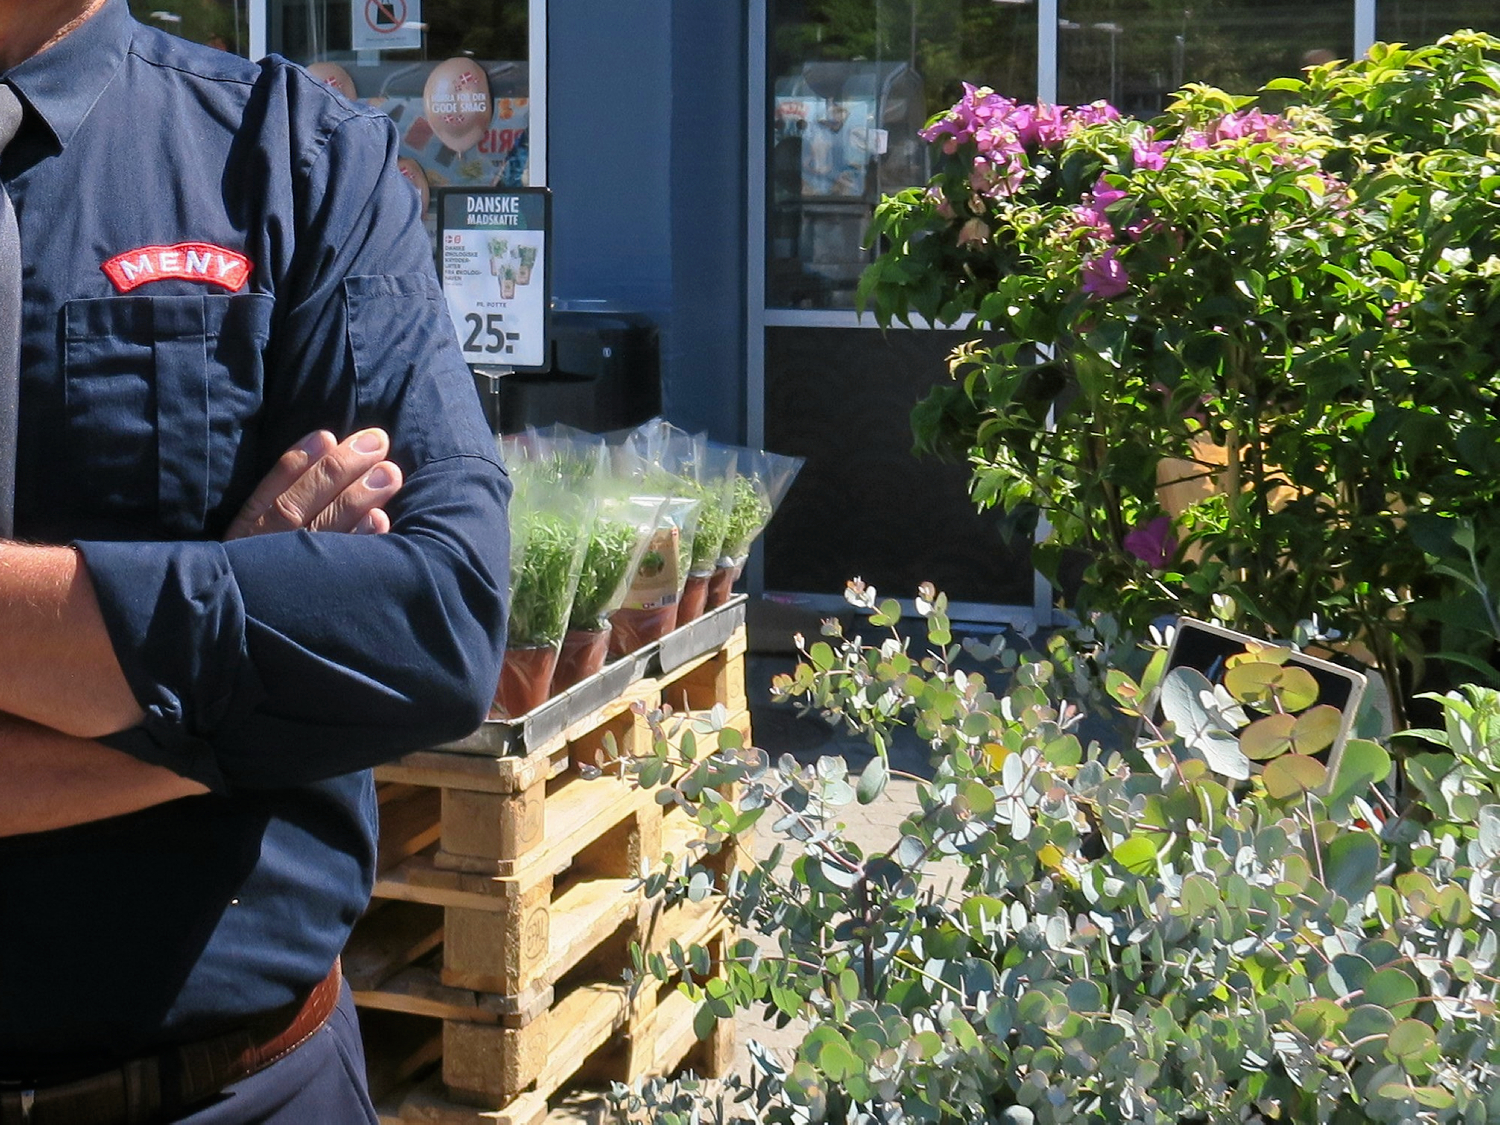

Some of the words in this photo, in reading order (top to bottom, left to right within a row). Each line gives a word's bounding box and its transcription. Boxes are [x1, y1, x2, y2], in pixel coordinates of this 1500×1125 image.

[432, 103, 457, 113] GODE
[460, 102, 487, 113] SMAG
[467, 196, 520, 214] DANSKE
[467, 214, 519, 226] MADSKATTE
[119, 250, 240, 281] MENY
